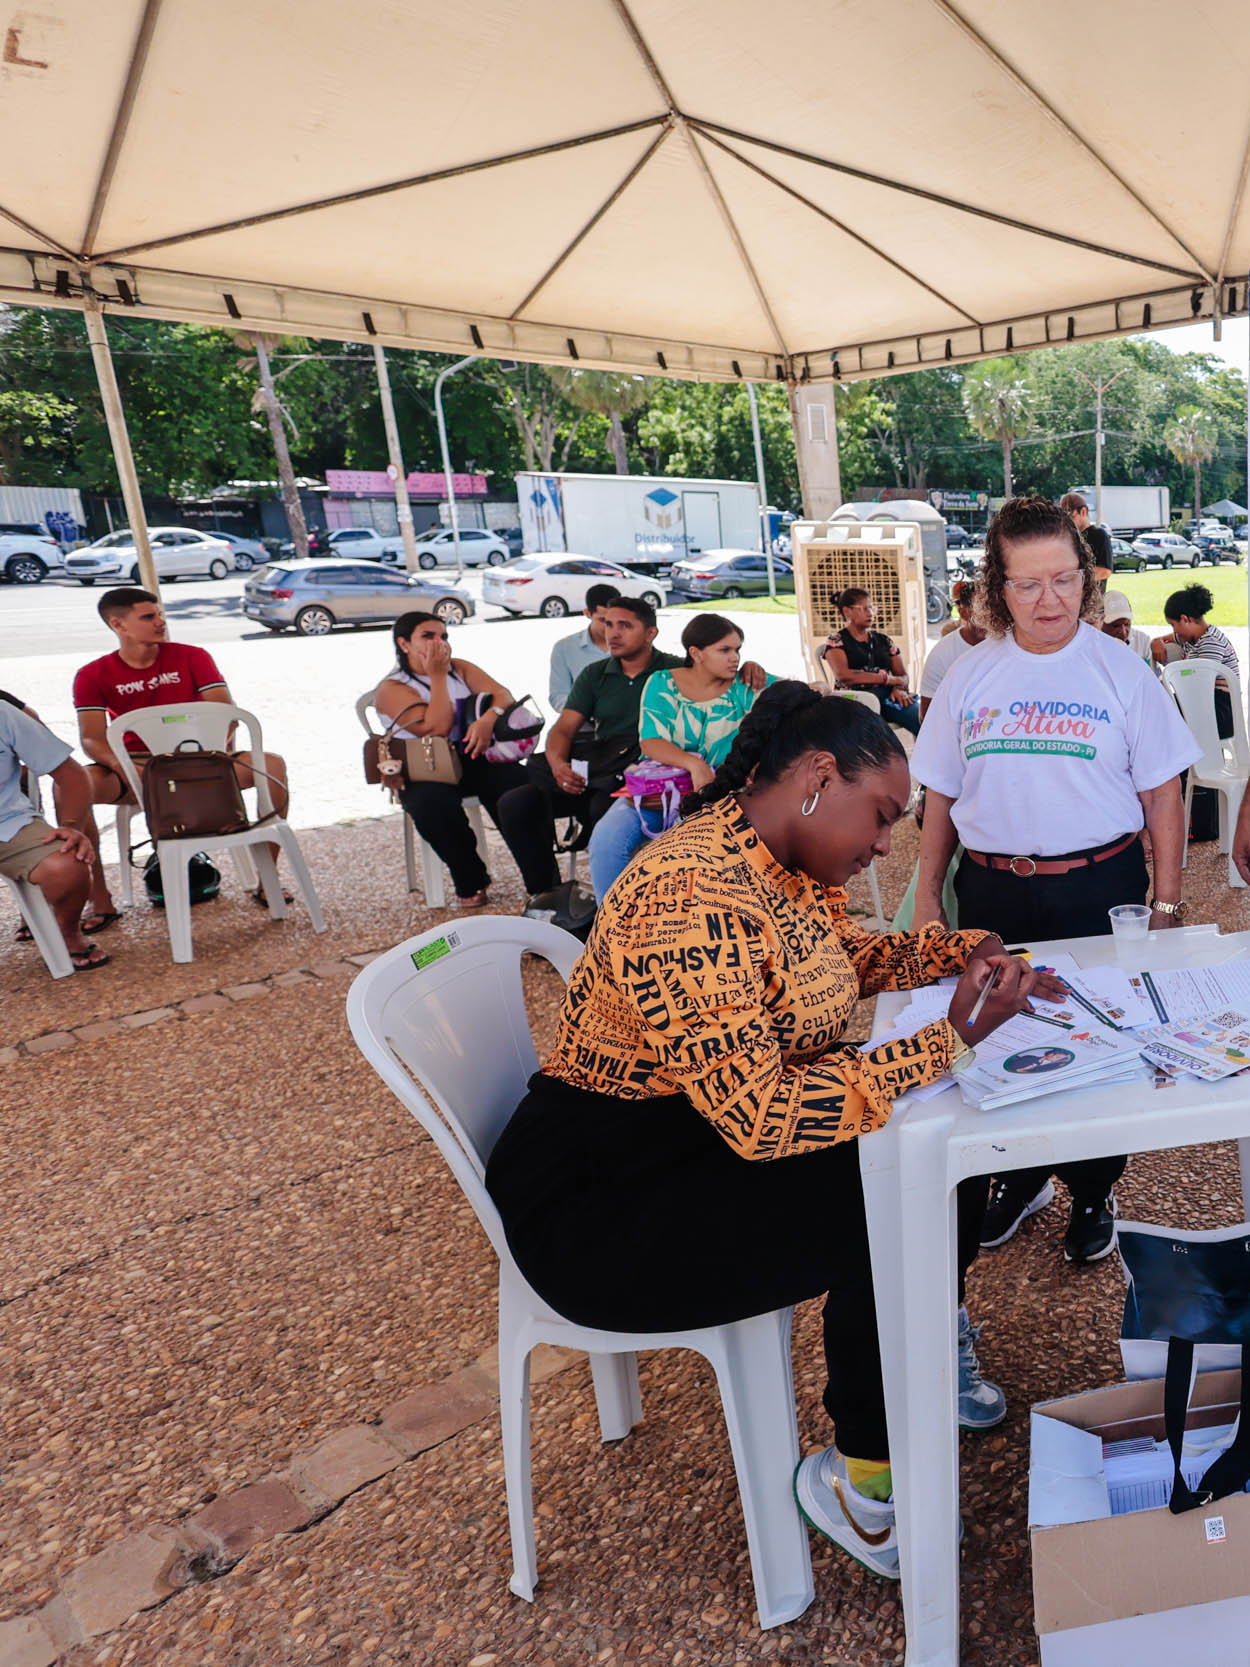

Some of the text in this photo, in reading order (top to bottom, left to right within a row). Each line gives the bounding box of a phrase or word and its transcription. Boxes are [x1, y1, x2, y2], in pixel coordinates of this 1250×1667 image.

[1001, 705, 1096, 739] Ativa
[1009, 701, 1111, 724] OUVIDORIA
[1003, 740, 1031, 750] GERAL
[1032, 741, 1046, 750] DO
[1046, 741, 1081, 753] ESTADO
[705, 912, 763, 942] NEW
[575, 1043, 630, 1082] TRAVEL
